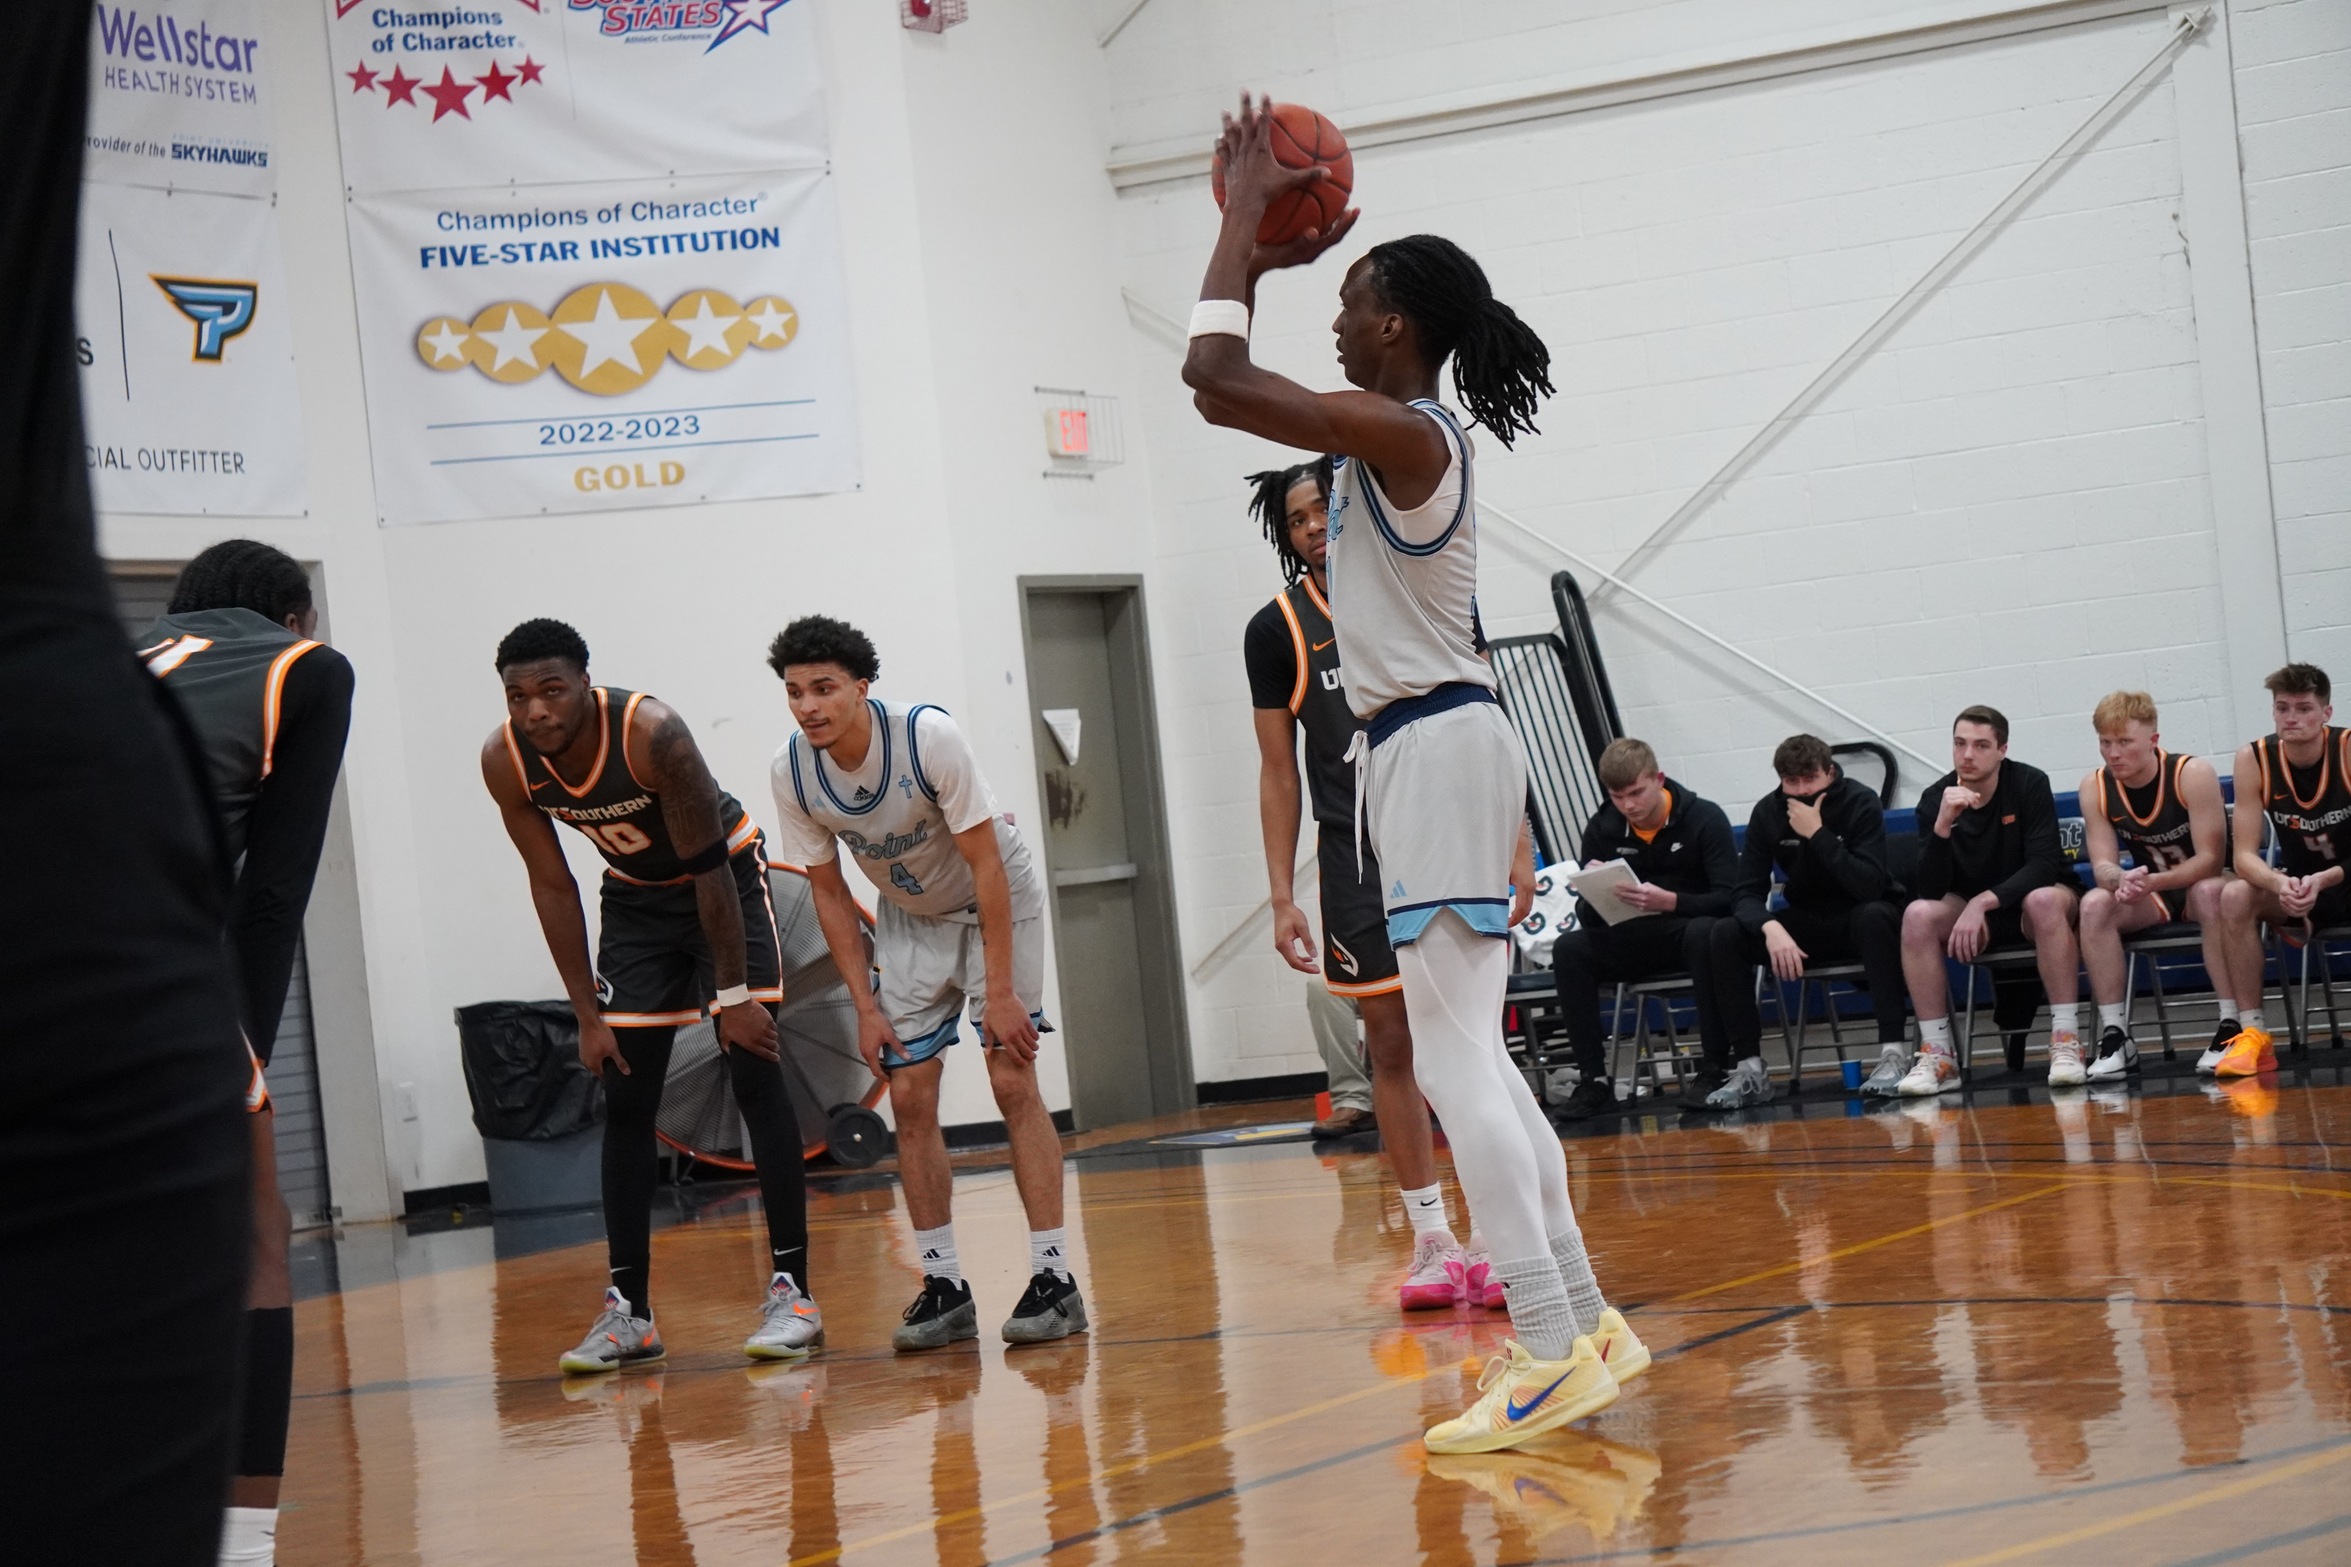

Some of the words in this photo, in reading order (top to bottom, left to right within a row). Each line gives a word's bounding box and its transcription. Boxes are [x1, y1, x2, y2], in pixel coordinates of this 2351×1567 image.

[372, 7, 503, 29] Champions
[601, 1, 723, 35] STATES
[97, 4, 258, 73] Wellstar
[372, 33, 394, 53] of
[403, 30, 516, 51] Character
[105, 66, 180, 94] HEALTH
[185, 76, 257, 105] SYSTEM
[86, 135, 131, 153] rovider
[134, 140, 146, 155] of
[149, 142, 166, 158] the
[171, 142, 268, 168] SKYHAWKS
[437, 206, 588, 233] Champions
[597, 203, 622, 223] of
[630, 196, 758, 221] Character
[420, 241, 579, 269] FIVE-STAR
[590, 227, 781, 260] INSTITUTION
[539, 414, 700, 445] 2022-2023
[85, 445, 131, 470] CIAL
[137, 447, 245, 474] OUTFITTER
[574, 461, 685, 492] GOLD
[578, 822, 652, 856] 10
[838, 819, 927, 860] Point
[2303, 833, 2336, 860] 4
[890, 863, 924, 895] 4
